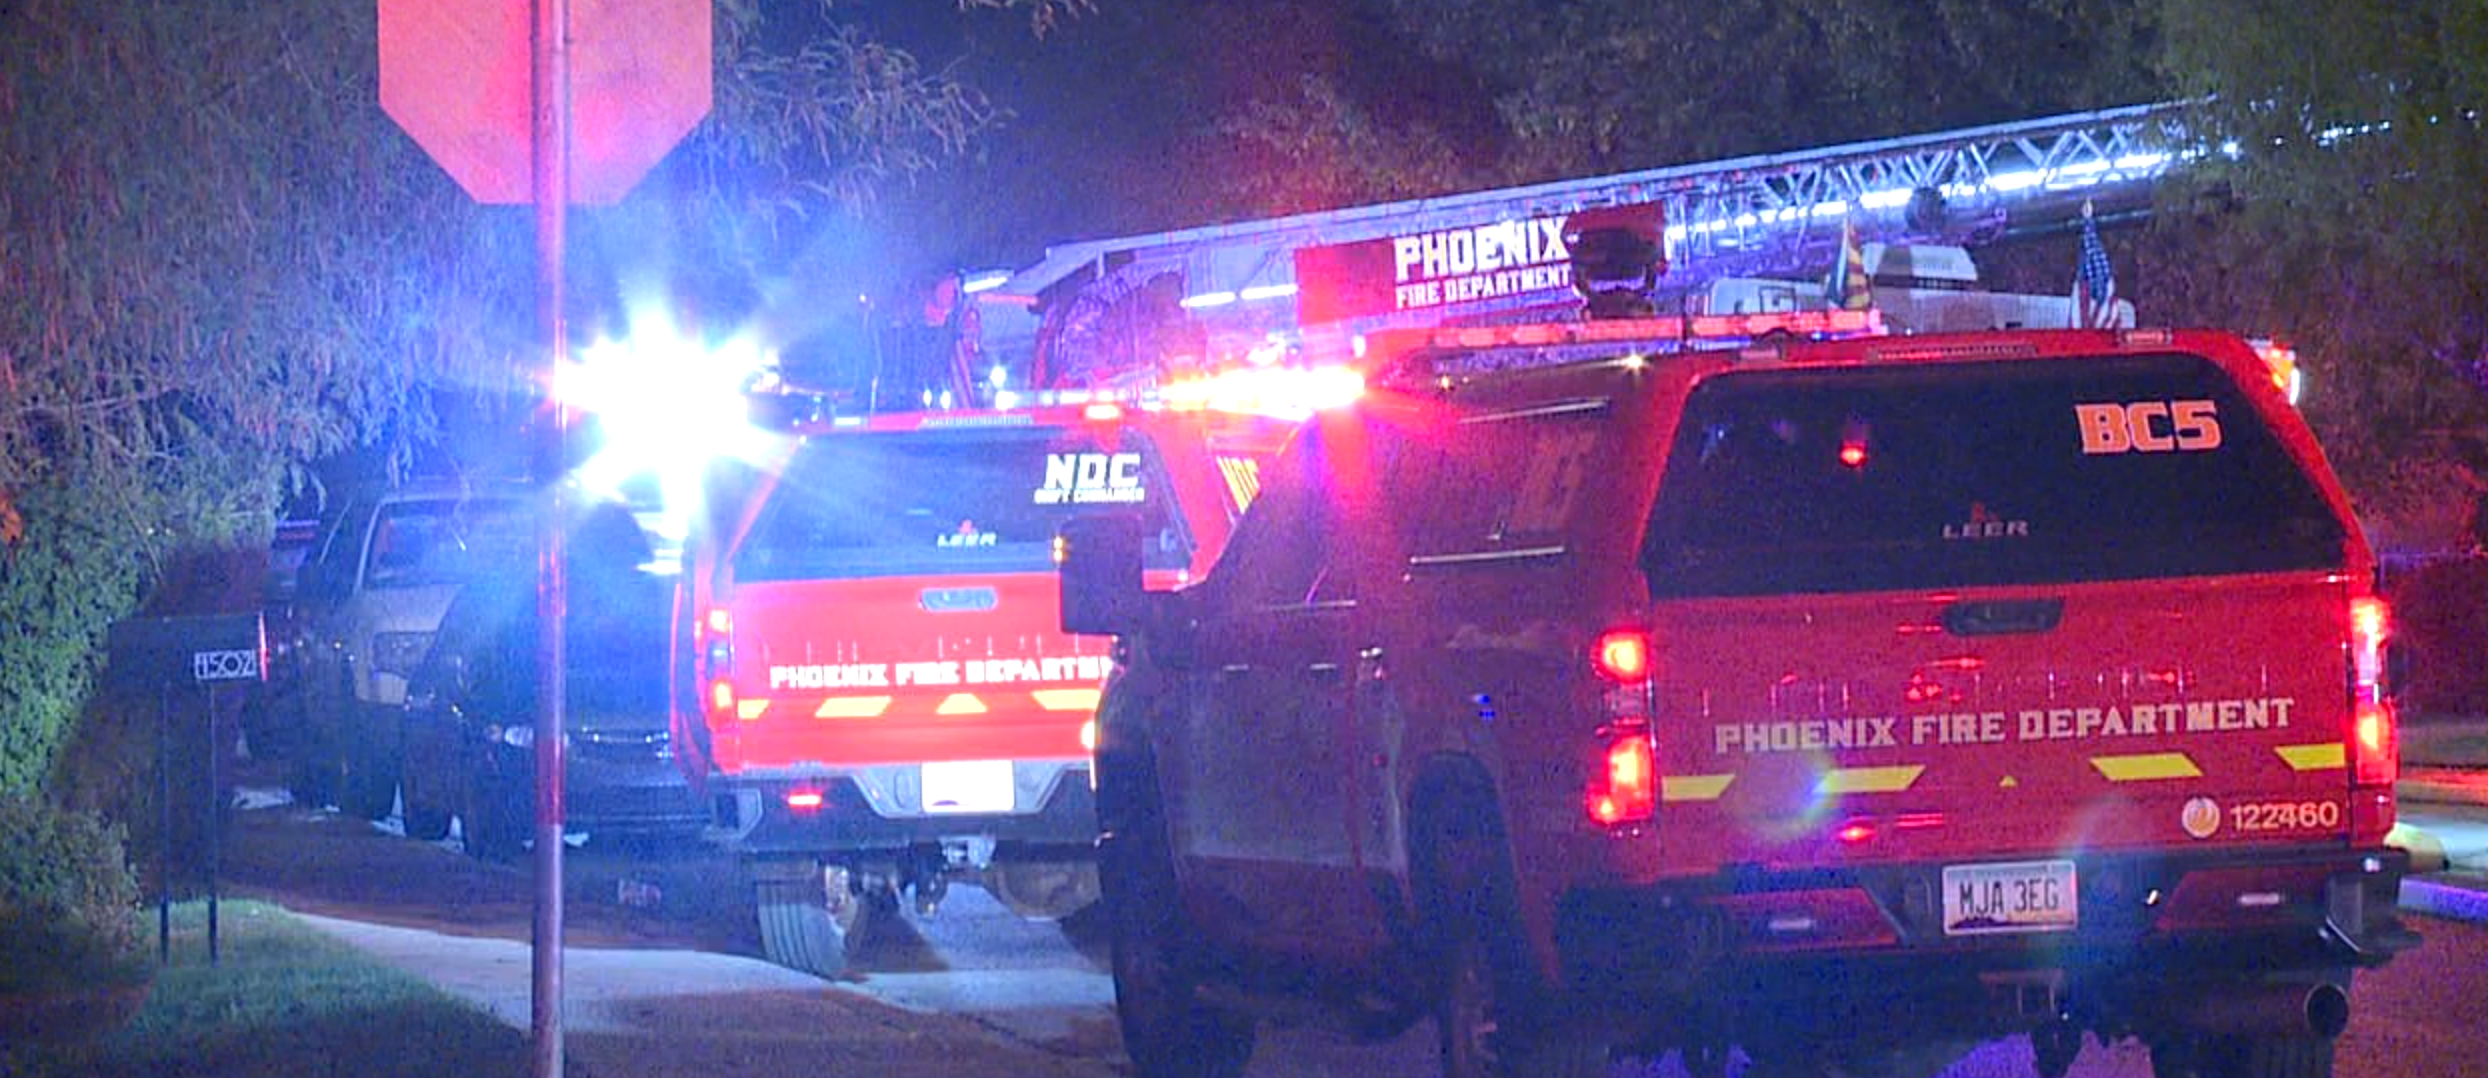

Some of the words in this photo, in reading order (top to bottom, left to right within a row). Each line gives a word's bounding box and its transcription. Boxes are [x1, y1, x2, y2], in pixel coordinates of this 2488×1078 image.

[1394, 216, 1570, 283] PHOENIX
[1396, 281, 1441, 309] FIRE
[1443, 262, 1572, 304] DEPARTMENT
[2075, 400, 2221, 454] BC5
[1044, 453, 1141, 489] NDC
[1942, 520, 2028, 539] LEER
[769, 664, 889, 689] PHOENIX
[895, 661, 960, 686] FIRE
[1715, 718, 1896, 753] PHOENIX
[1913, 711, 2006, 745] FIRE
[2018, 697, 2295, 743] DEPARTMENT
[2231, 801, 2338, 830] 122460
[1959, 880, 2005, 916] MJA
[2013, 877, 2060, 913] 3EG
